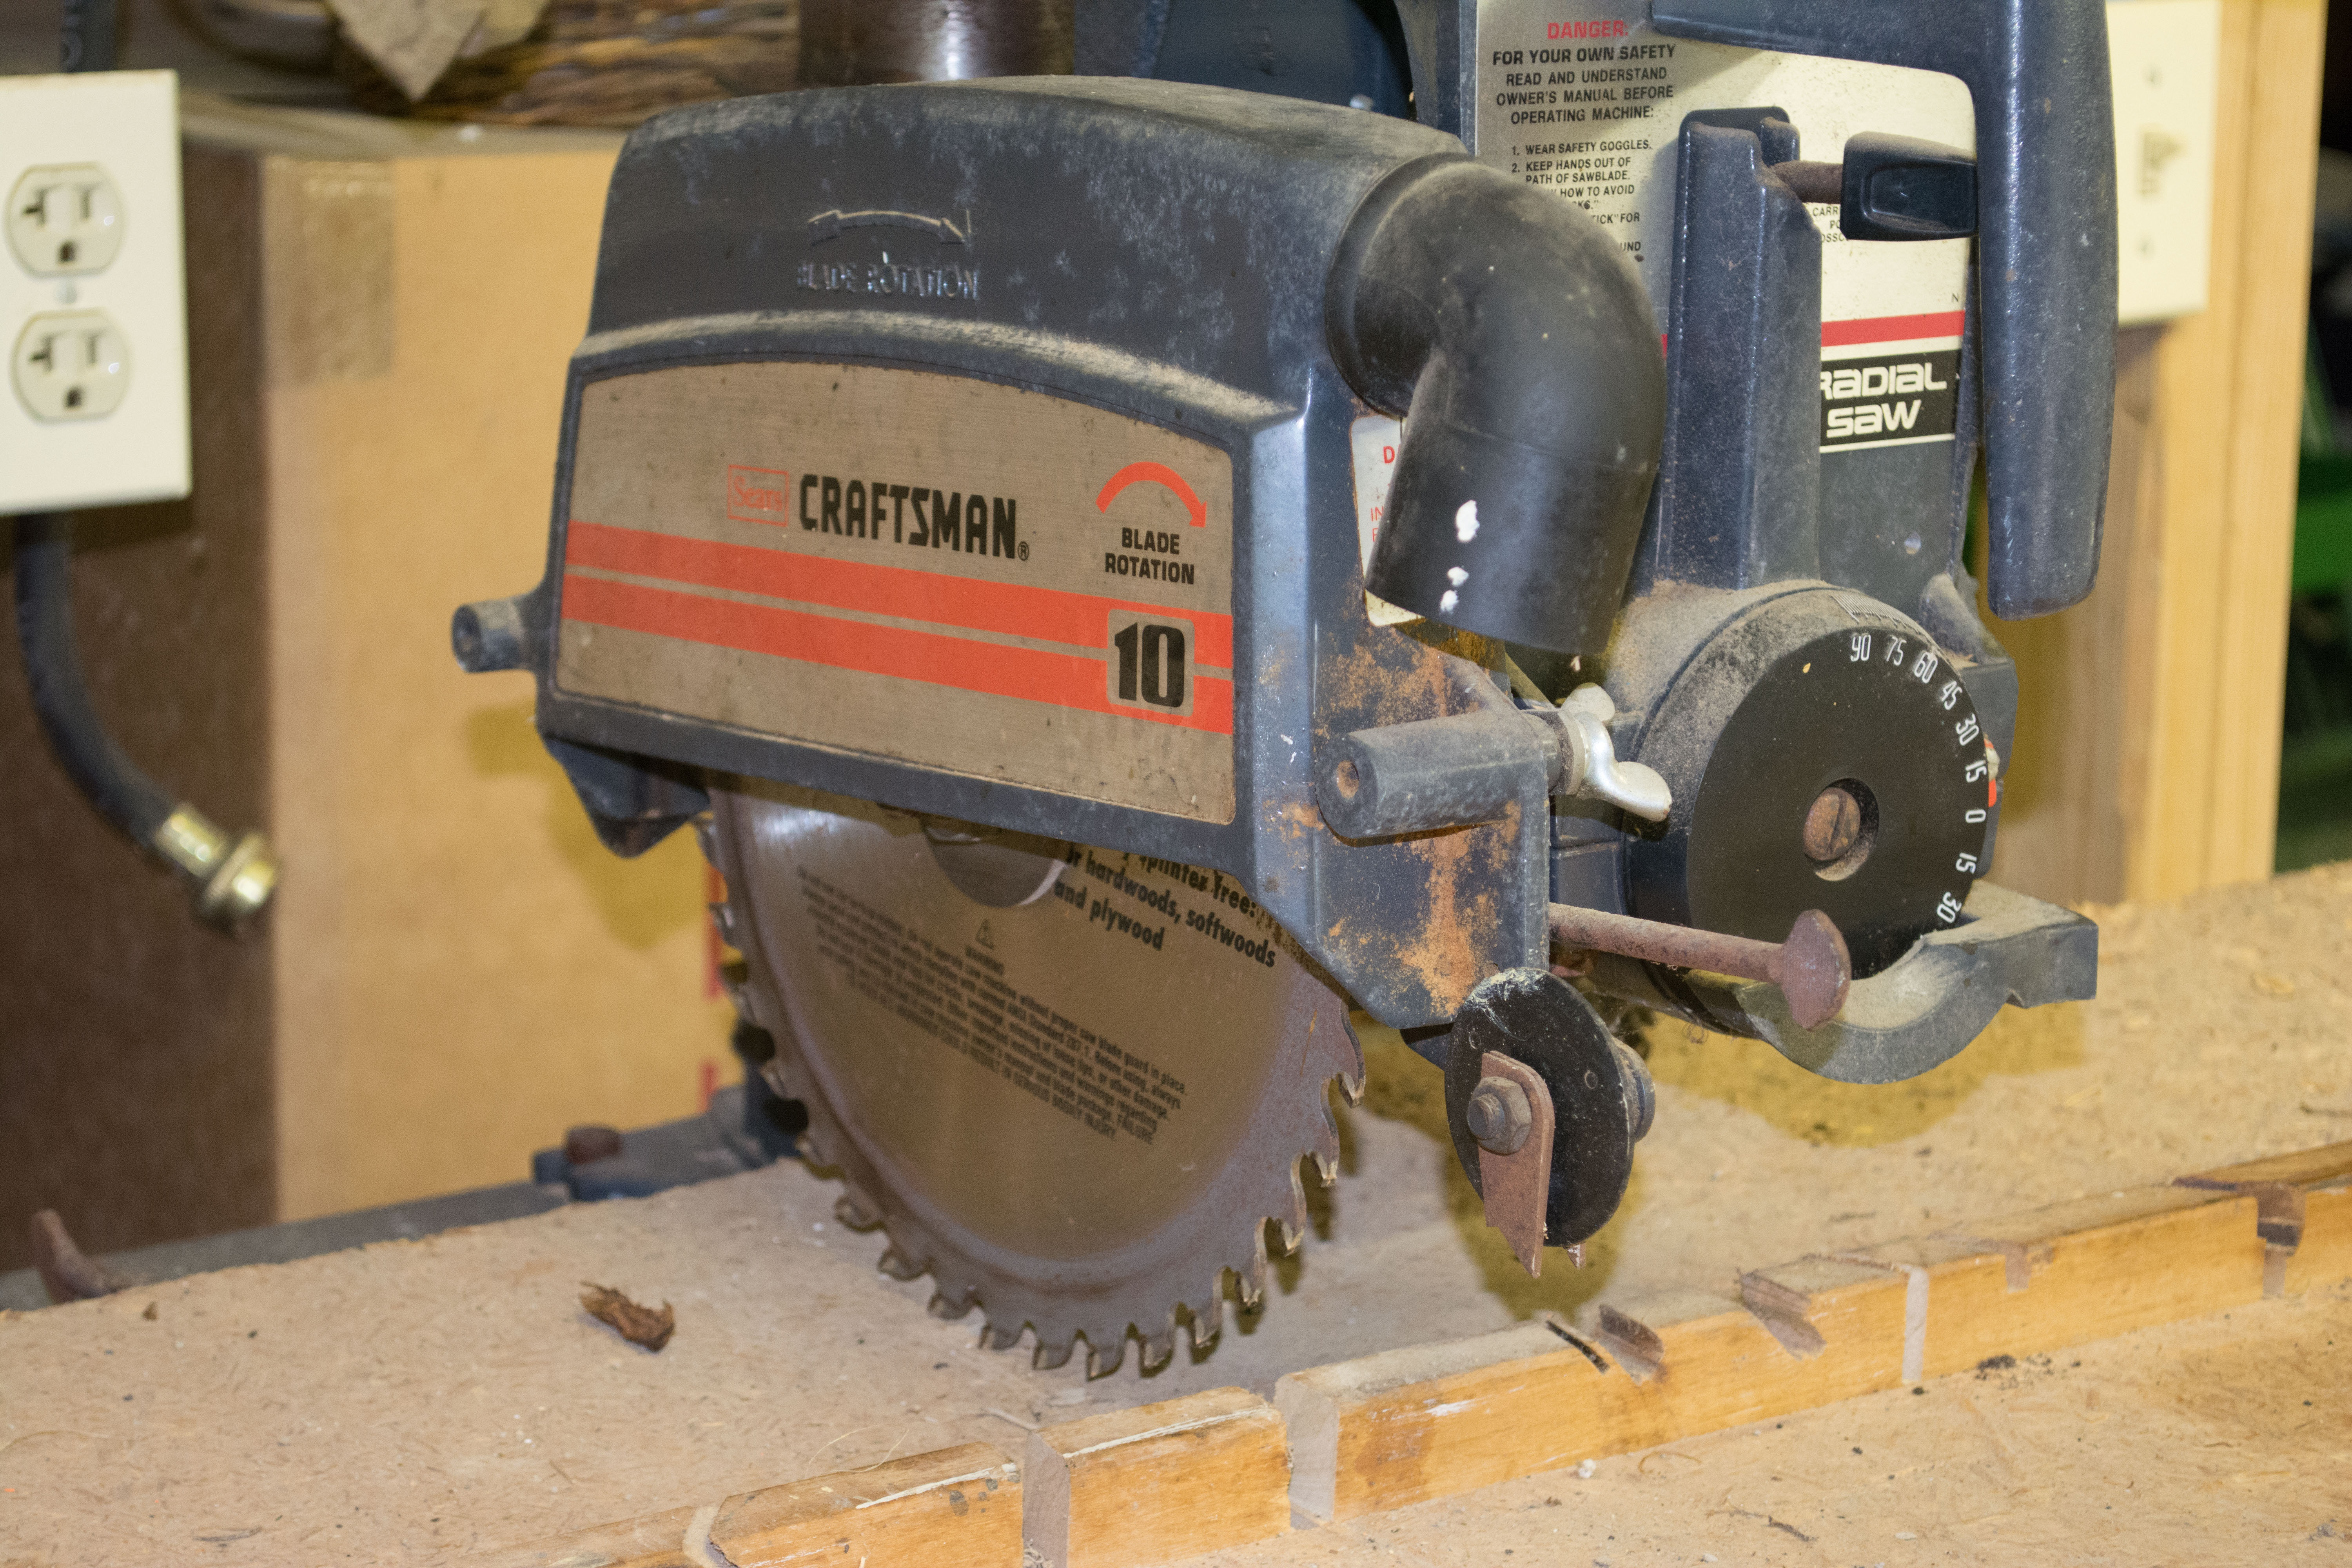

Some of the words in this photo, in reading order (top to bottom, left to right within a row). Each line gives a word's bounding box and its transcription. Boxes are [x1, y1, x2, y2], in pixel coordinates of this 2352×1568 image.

[1547, 20, 1629, 39] DANGER:
[1493, 50, 1523, 65] FOR
[1530, 49, 1571, 63] YOUR
[1577, 47, 1614, 62] OWN
[1619, 44, 1676, 60] SAFETY
[1506, 72, 1541, 86] READ
[1548, 71, 1575, 85] AND
[1582, 67, 1667, 83] UNDERSTAND
[1496, 91, 1557, 106] OWNER'S
[1563, 89, 1617, 103] MANUAL
[1624, 85, 1673, 100] BEFORE
[1511, 109, 1585, 125] OPERATING
[1592, 105, 1653, 120] MACHINE:
[1512, 146, 1520, 156] 1.
[1525, 144, 1555, 155] WEAR
[1559, 142, 1596, 153] SAFETY
[1600, 140, 1651, 151] GOGGLES.
[1512, 163, 1520, 172] 2.
[1526, 161, 1553, 172] KEEP
[1555, 159, 1591, 170] HANDS
[1594, 158, 1615, 168] OUT
[1618, 157, 1631, 167] OF
[1526, 174, 1552, 184] PATH
[1555, 173, 1570, 183] OF
[1572, 170, 1630, 182] SAWBLADE.
[1560, 187, 1583, 198] HOW
[1587, 187, 1600, 196] TO
[1603, 184, 1635, 195] AVOID
[1620, 212, 1640, 223] FOR
[1813, 206, 1838, 216] CARR
[1620, 241, 1641, 252] UND
[1820, 362, 1947, 400] RADIAL
[1826, 399, 1921, 438] SAW
[733, 475, 783, 512] Sears
[1122, 527, 1180, 555] BLADE
[1105, 552, 1194, 585] ROTATION
[1850, 633, 1871, 662] 90
[1886, 635, 1907, 666] 75
[1114, 622, 1185, 707] 10
[1914, 651, 1938, 684] 60
[1941, 681, 1963, 710] 45
[1956, 713, 1979, 746] 30
[1965, 760, 1987, 783] 15
[1965, 809, 1986, 823] 0
[1956, 852, 1977, 874] 15
[1054, 880, 1087, 909] and
[1089, 897, 1165, 951] plywood
[1086, 850, 1181, 924] hardwoods,
[1185, 911, 1276, 967] softwoods
[1936, 892, 1962, 924] 30
